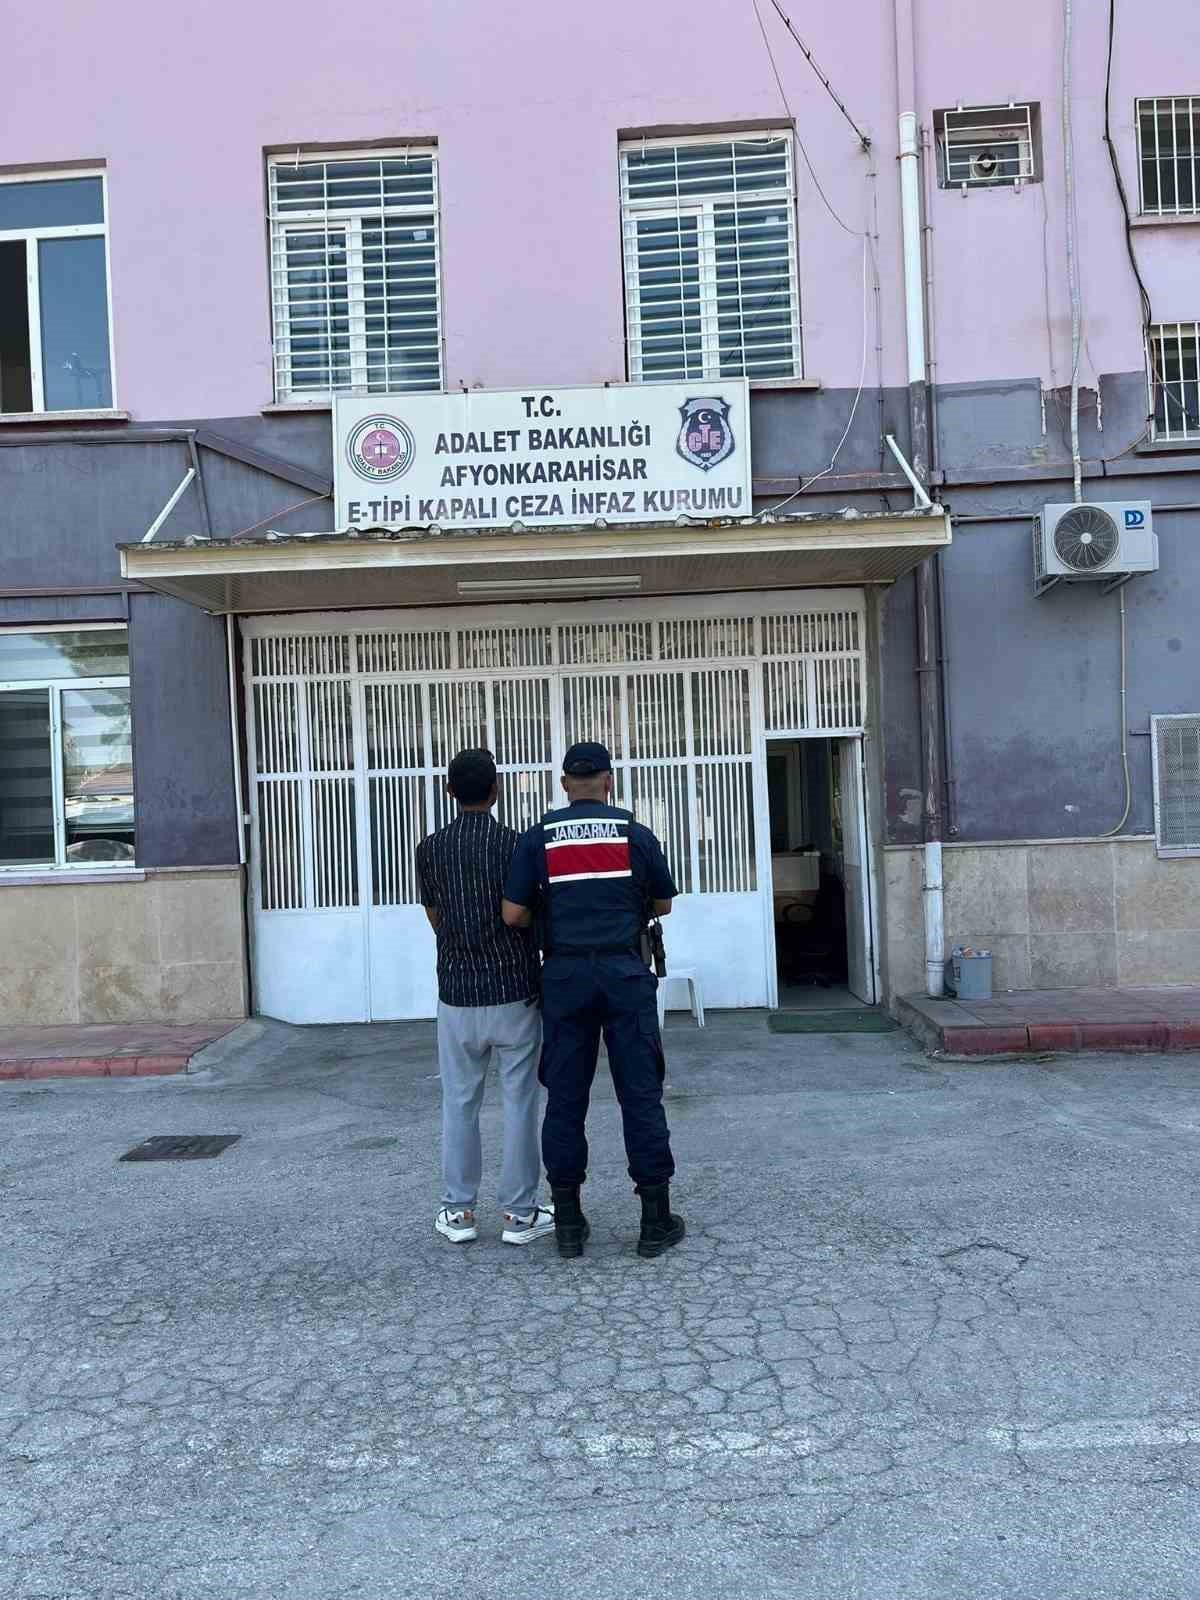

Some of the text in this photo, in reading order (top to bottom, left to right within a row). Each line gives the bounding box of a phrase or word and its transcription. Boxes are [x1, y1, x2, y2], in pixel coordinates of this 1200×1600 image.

[521, 396, 561, 418] T.C.
[435, 420, 652, 455] ADALET BAKANLIĞI
[440, 453, 648, 488] AFYONKARAHİSAR
[347, 486, 743, 524] E-TİPİ KAPALI CEZA İNFAZ KURUMU
[552, 823, 619, 841] JANDARMA
